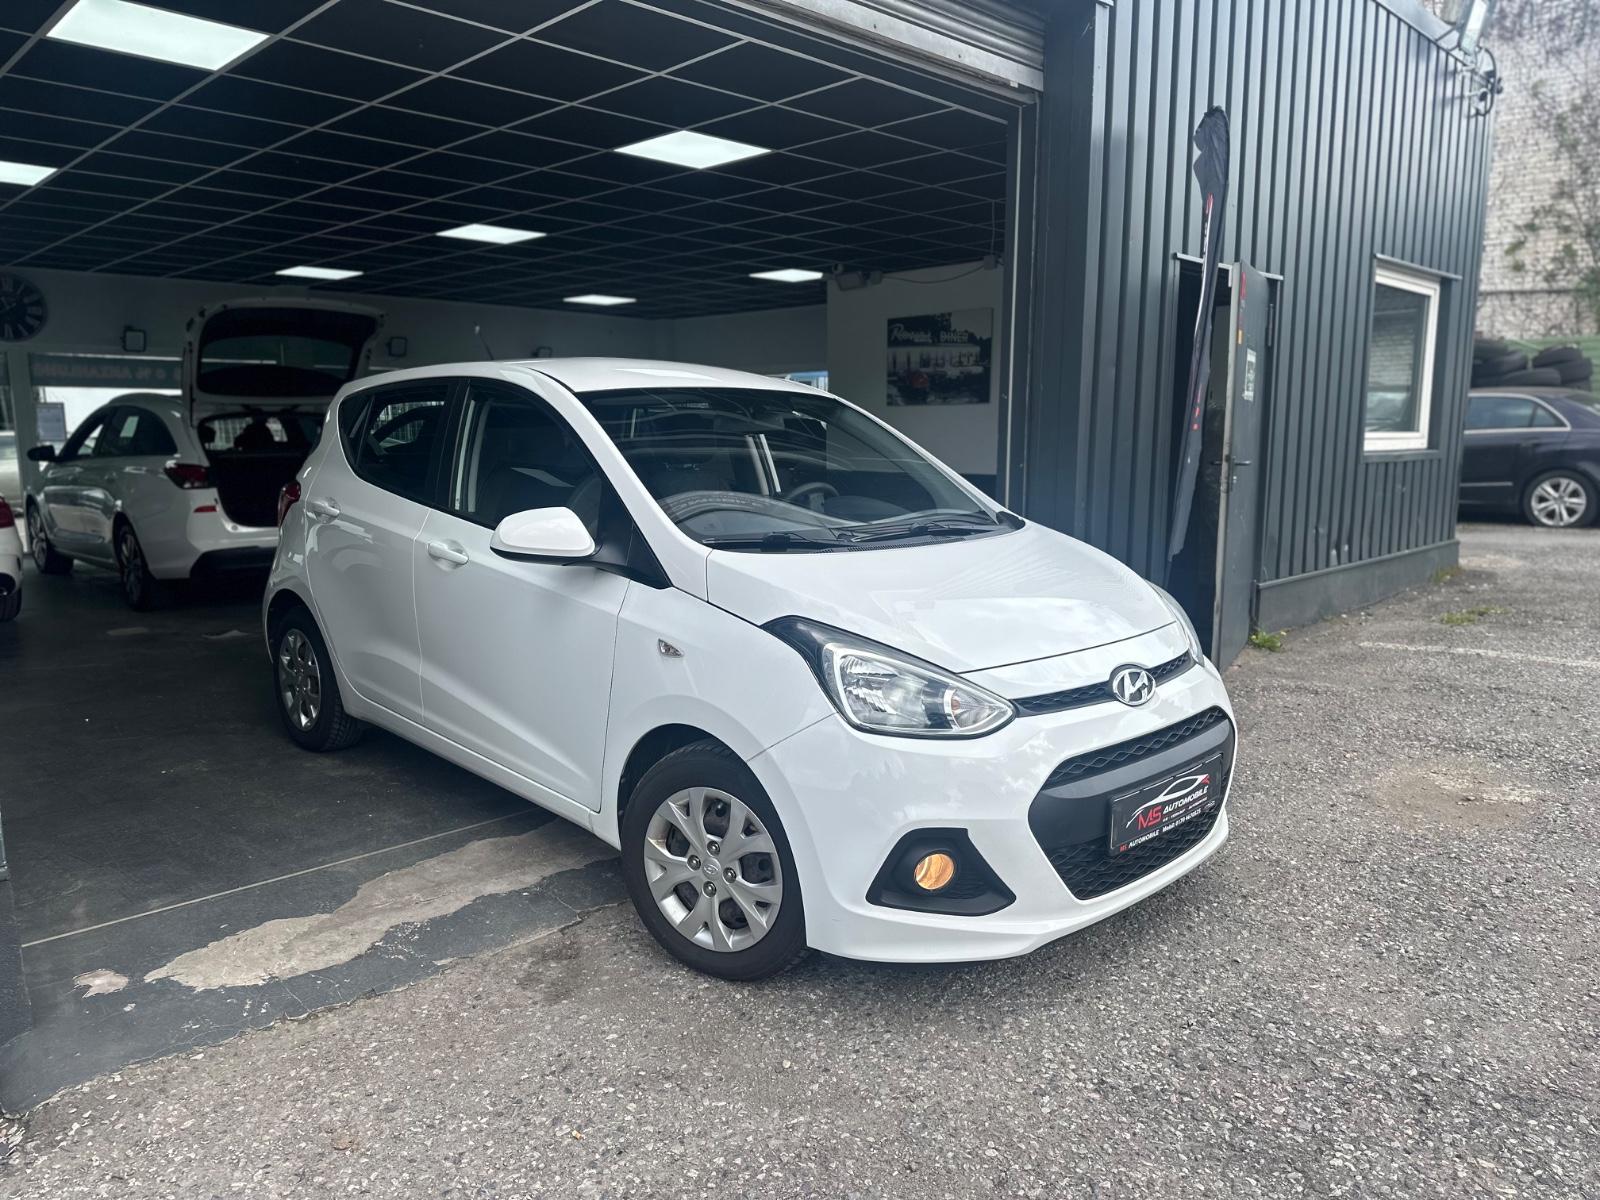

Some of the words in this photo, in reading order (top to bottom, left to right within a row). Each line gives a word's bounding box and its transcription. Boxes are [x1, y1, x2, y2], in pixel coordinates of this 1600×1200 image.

[1137, 805, 1163, 830] MS
[1162, 785, 1209, 815] AUTOMOBILE
[1128, 829, 1160, 848] AUTOMOBILE
